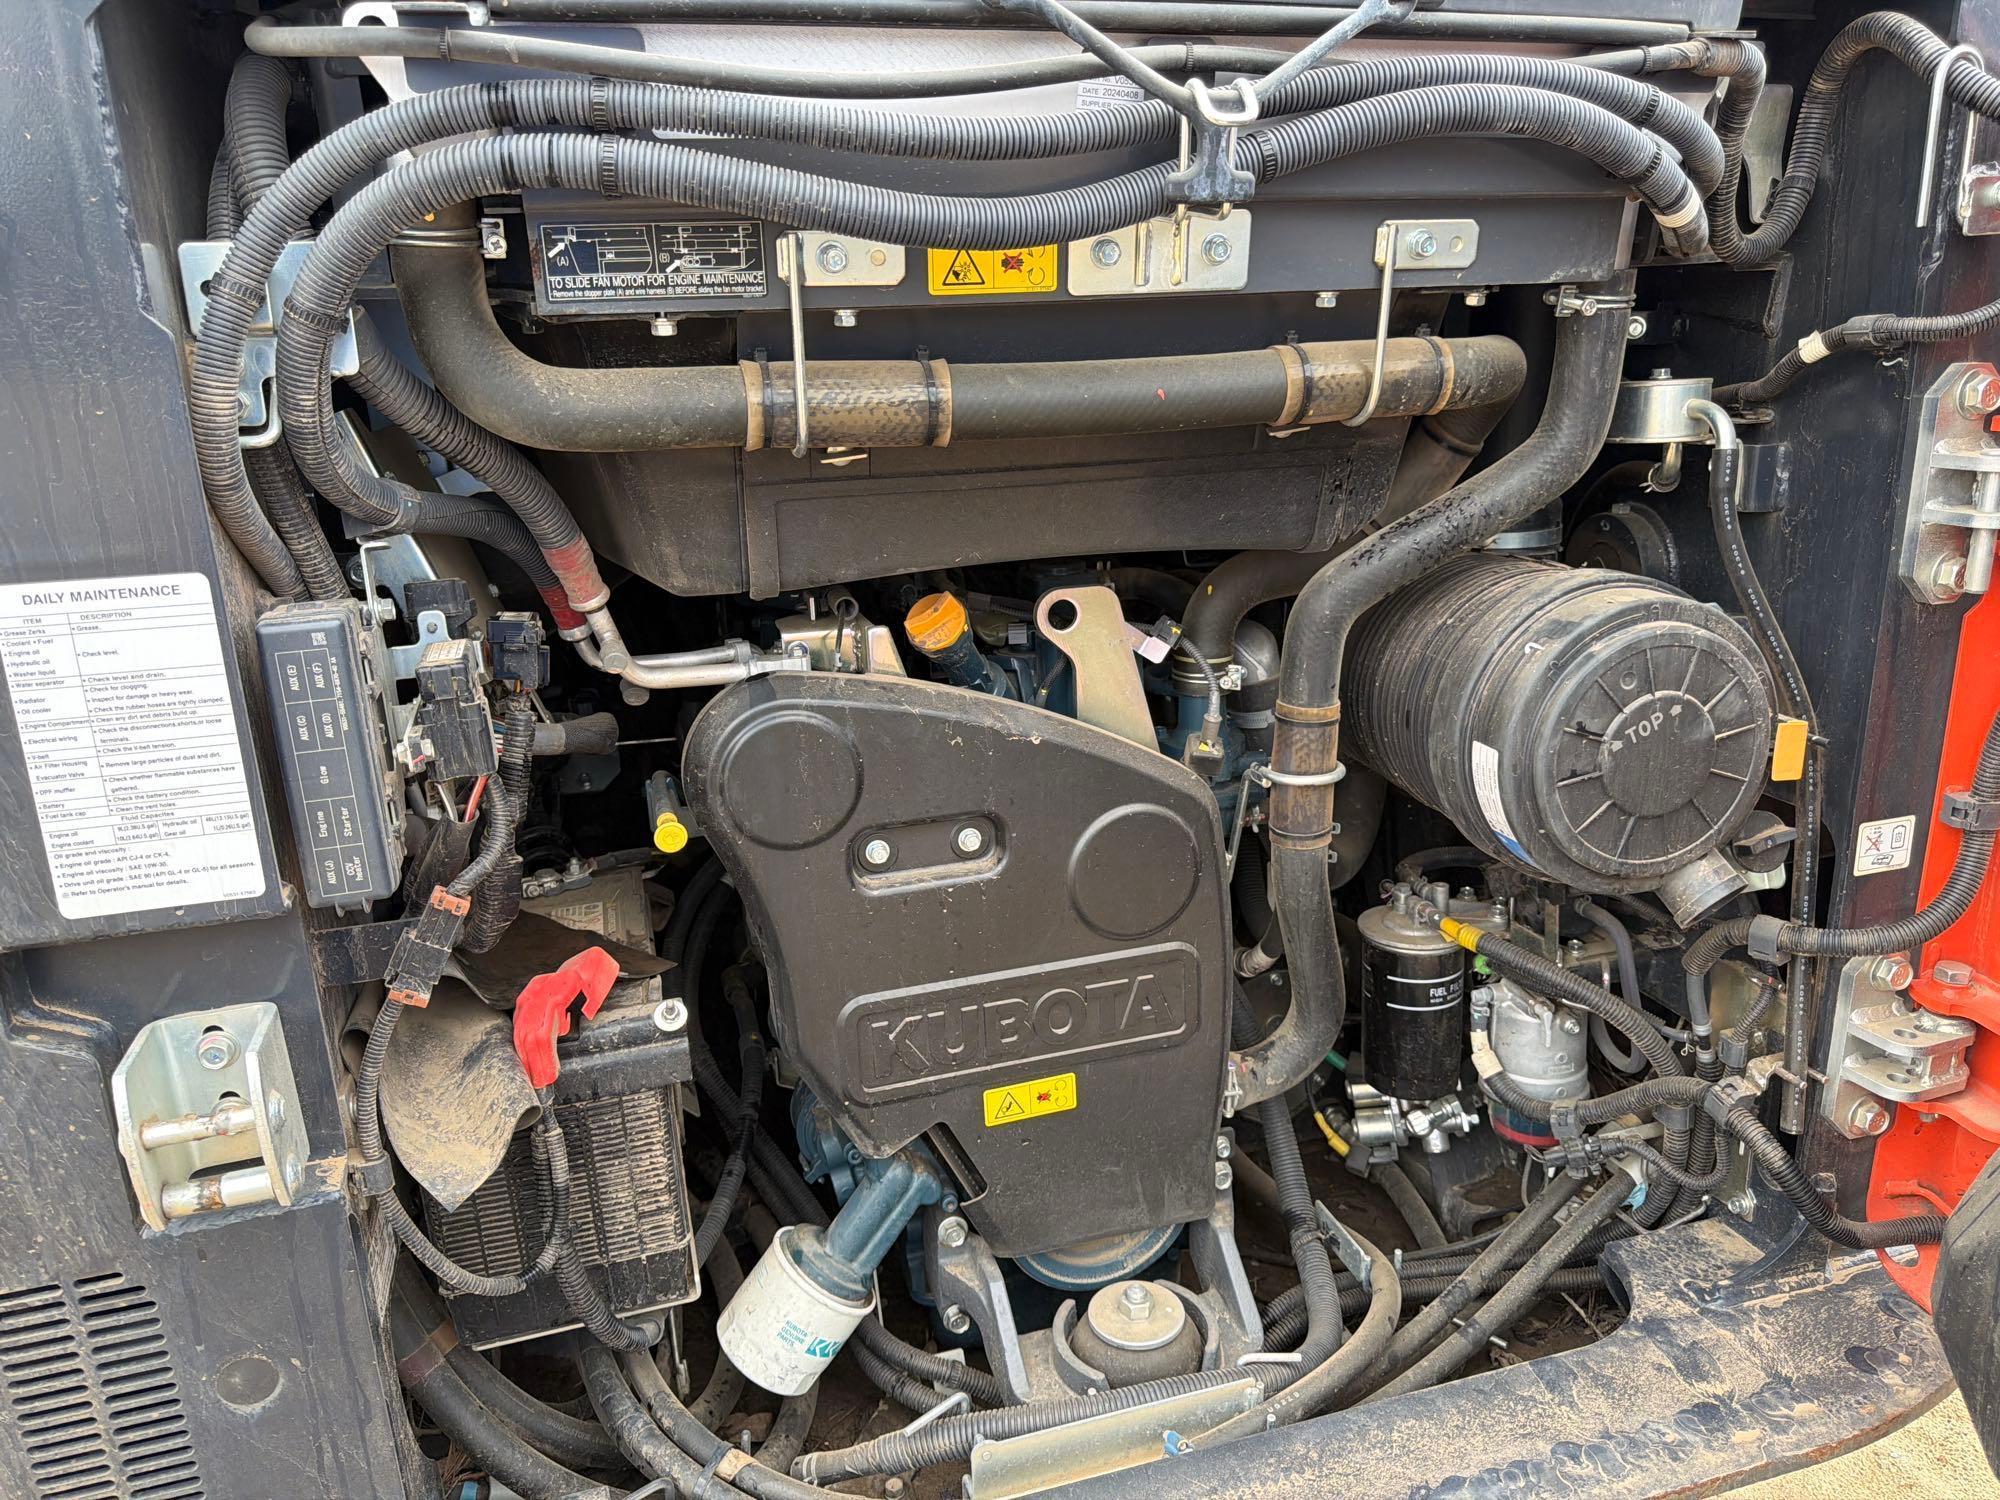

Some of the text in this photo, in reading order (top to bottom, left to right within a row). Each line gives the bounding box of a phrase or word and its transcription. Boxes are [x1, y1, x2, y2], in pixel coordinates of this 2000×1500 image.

[1102, 88, 1139, 99] 20240408
[1081, 100, 1111, 108] SUPPLIER
[556, 256, 569, 267] (A)
[659, 252, 671, 264] (B)
[549, 272, 764, 289] TO SLIDE FAN MOTOR FOR ENGINE MAINTENANCE
[584, 290, 602, 299] stopper
[603, 289, 615, 298] plate
[616, 288, 625, 297] (A)
[625, 288, 635, 296] and
[667, 287, 675, 295] (B)
[21, 584, 180, 605] DAILY MAINTENANCE
[79, 611, 131, 620] DESCRIPTION
[5, 639, 31, 647] Coolant
[10, 659, 40, 668] Hydraulic
[287, 664, 300, 691] AUX(E)
[312, 662, 325, 688] AUX(F)
[47, 718, 91, 727] Compartment
[296, 715, 309, 741] AUX(C)
[321, 712, 335, 738] AUX(D)
[1624, 711, 1664, 744] TOP
[27, 736, 57, 744] Electrical
[320, 765, 329, 785] Glow
[316, 811, 328, 838] Engine
[341, 806, 352, 837] Starter
[64, 851, 83, 859] grade
[93, 858, 111, 866] grade
[353, 855, 364, 881] heater
[94, 866, 123, 874] viscosity
[324, 860, 337, 884] AUX(J)
[105, 876, 123, 884] grade
[97, 885, 130, 893] Operator's
[1430, 987, 1447, 997] FUEL
[870, 974, 1176, 1080] KUBOTA
[785, 1319, 808, 1338] KUBOTA
[776, 1331, 796, 1347] PARTS
